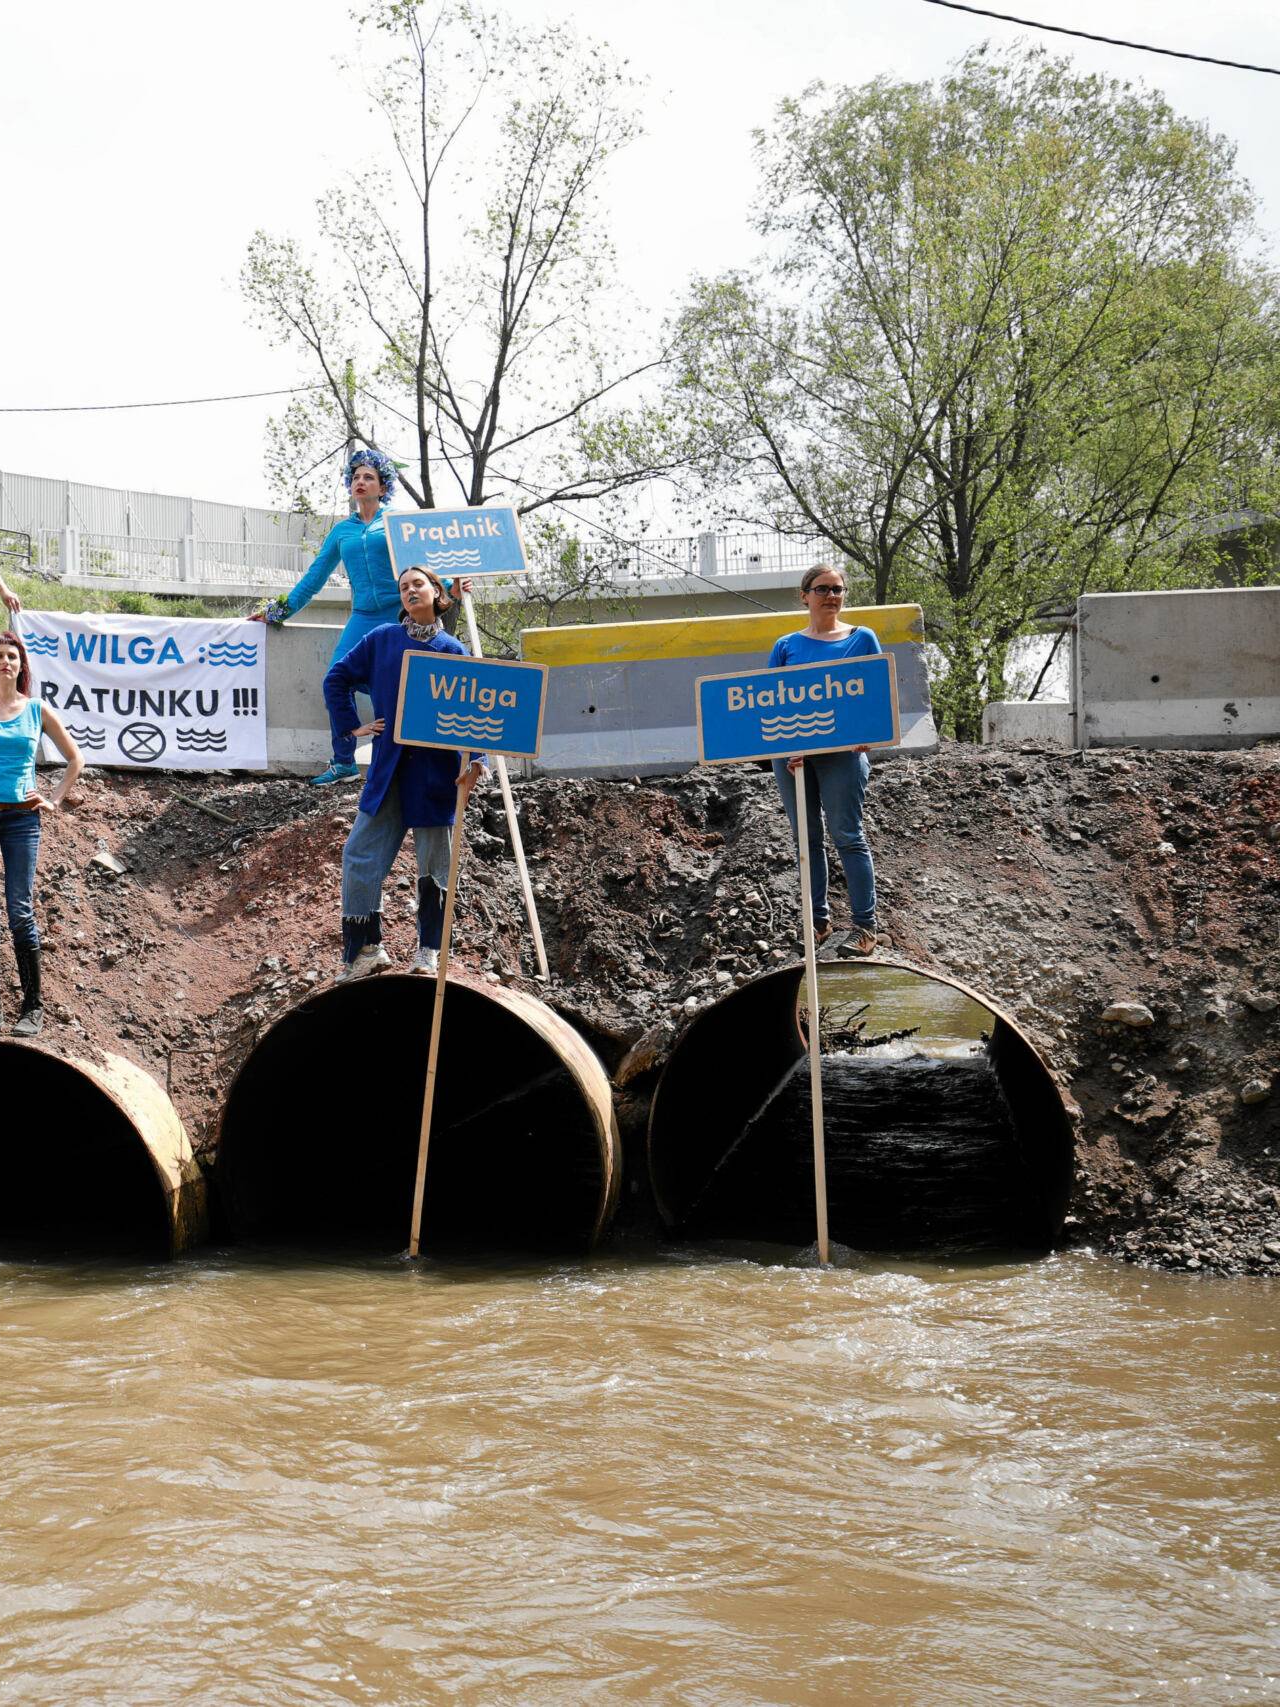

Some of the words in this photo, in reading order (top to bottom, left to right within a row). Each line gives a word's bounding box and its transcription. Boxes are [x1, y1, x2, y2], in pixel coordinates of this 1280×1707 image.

[400, 515, 503, 545] Prądnik
[65, 631, 185, 665] WILGA
[40, 680, 220, 717] RATUNKU
[429, 673, 518, 712] Wilga
[726, 673, 865, 711] Białucha
